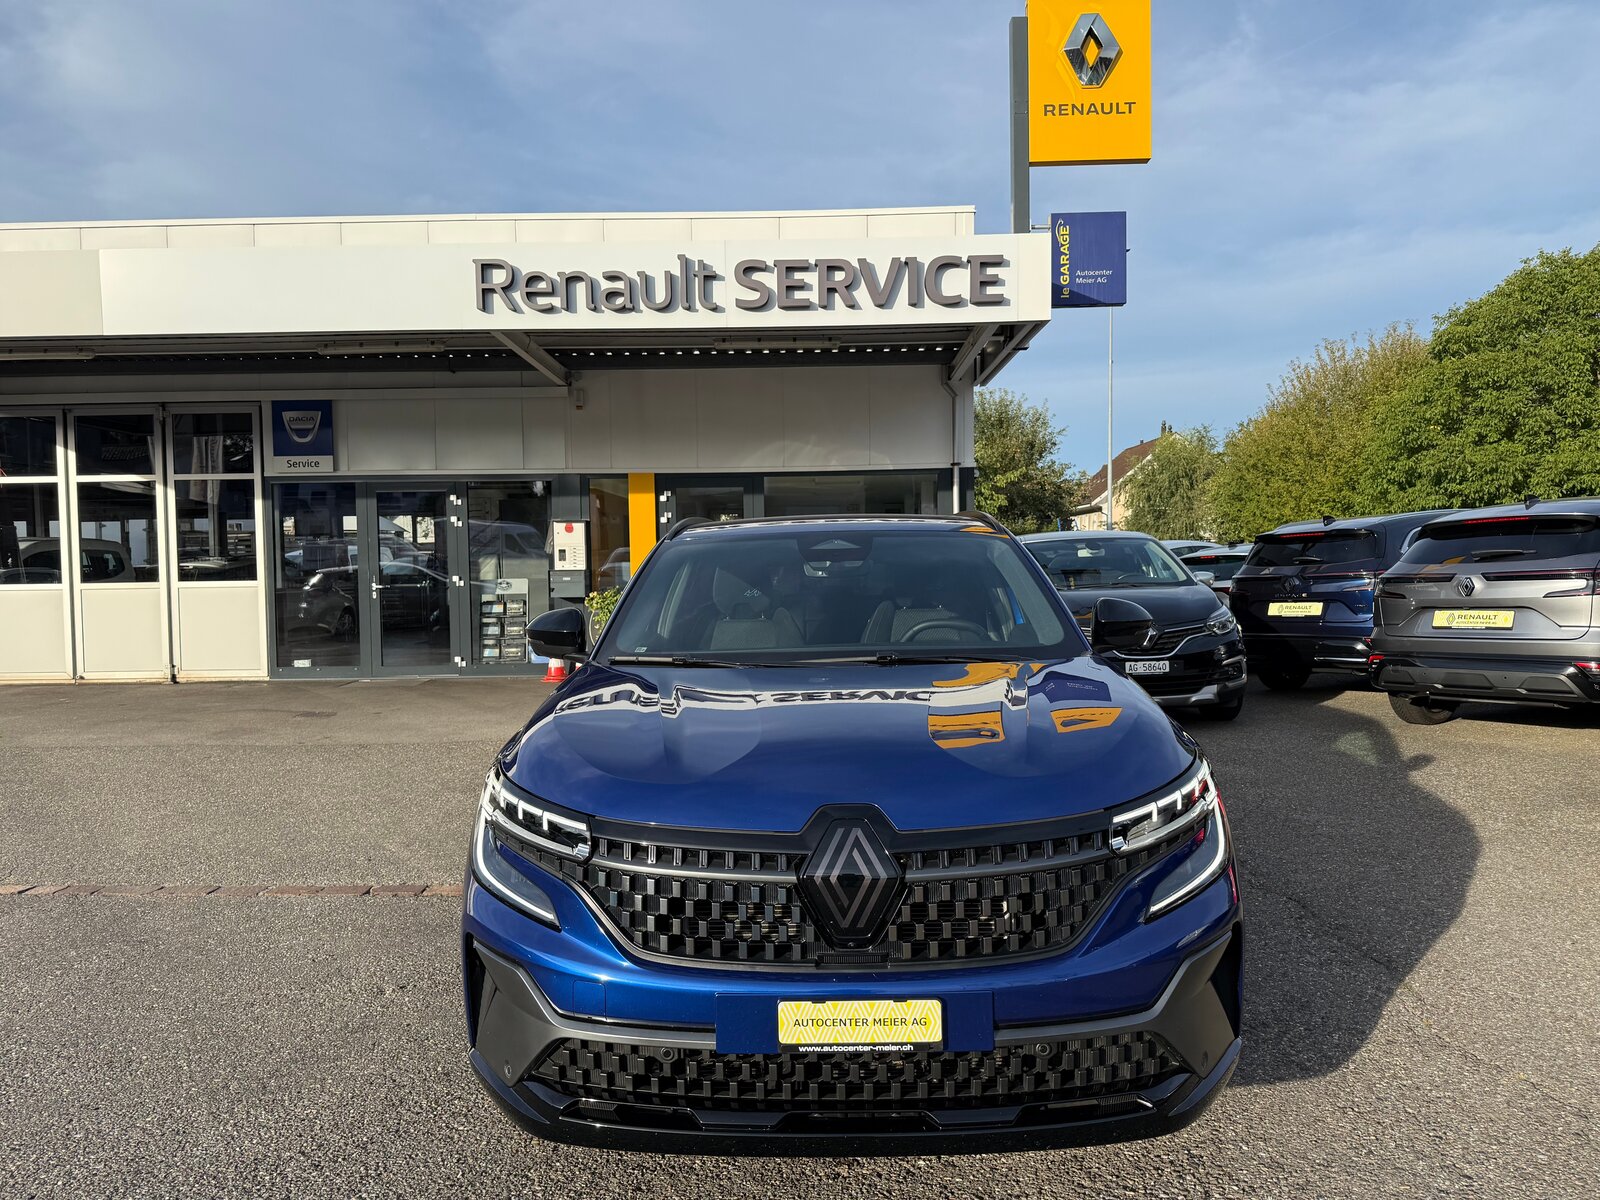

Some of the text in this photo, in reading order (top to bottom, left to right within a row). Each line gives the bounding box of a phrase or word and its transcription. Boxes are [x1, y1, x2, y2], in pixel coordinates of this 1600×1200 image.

[1043, 101, 1137, 117] RENAULT
[1060, 225, 1070, 299] le GARAGE
[472, 254, 1005, 313] Renault SERVICE
[286, 459, 320, 468] Service
[793, 1017, 928, 1028] AUTOCENTER MEIER AG
[798, 1044, 914, 1052] www.autocenter-meier.ch
